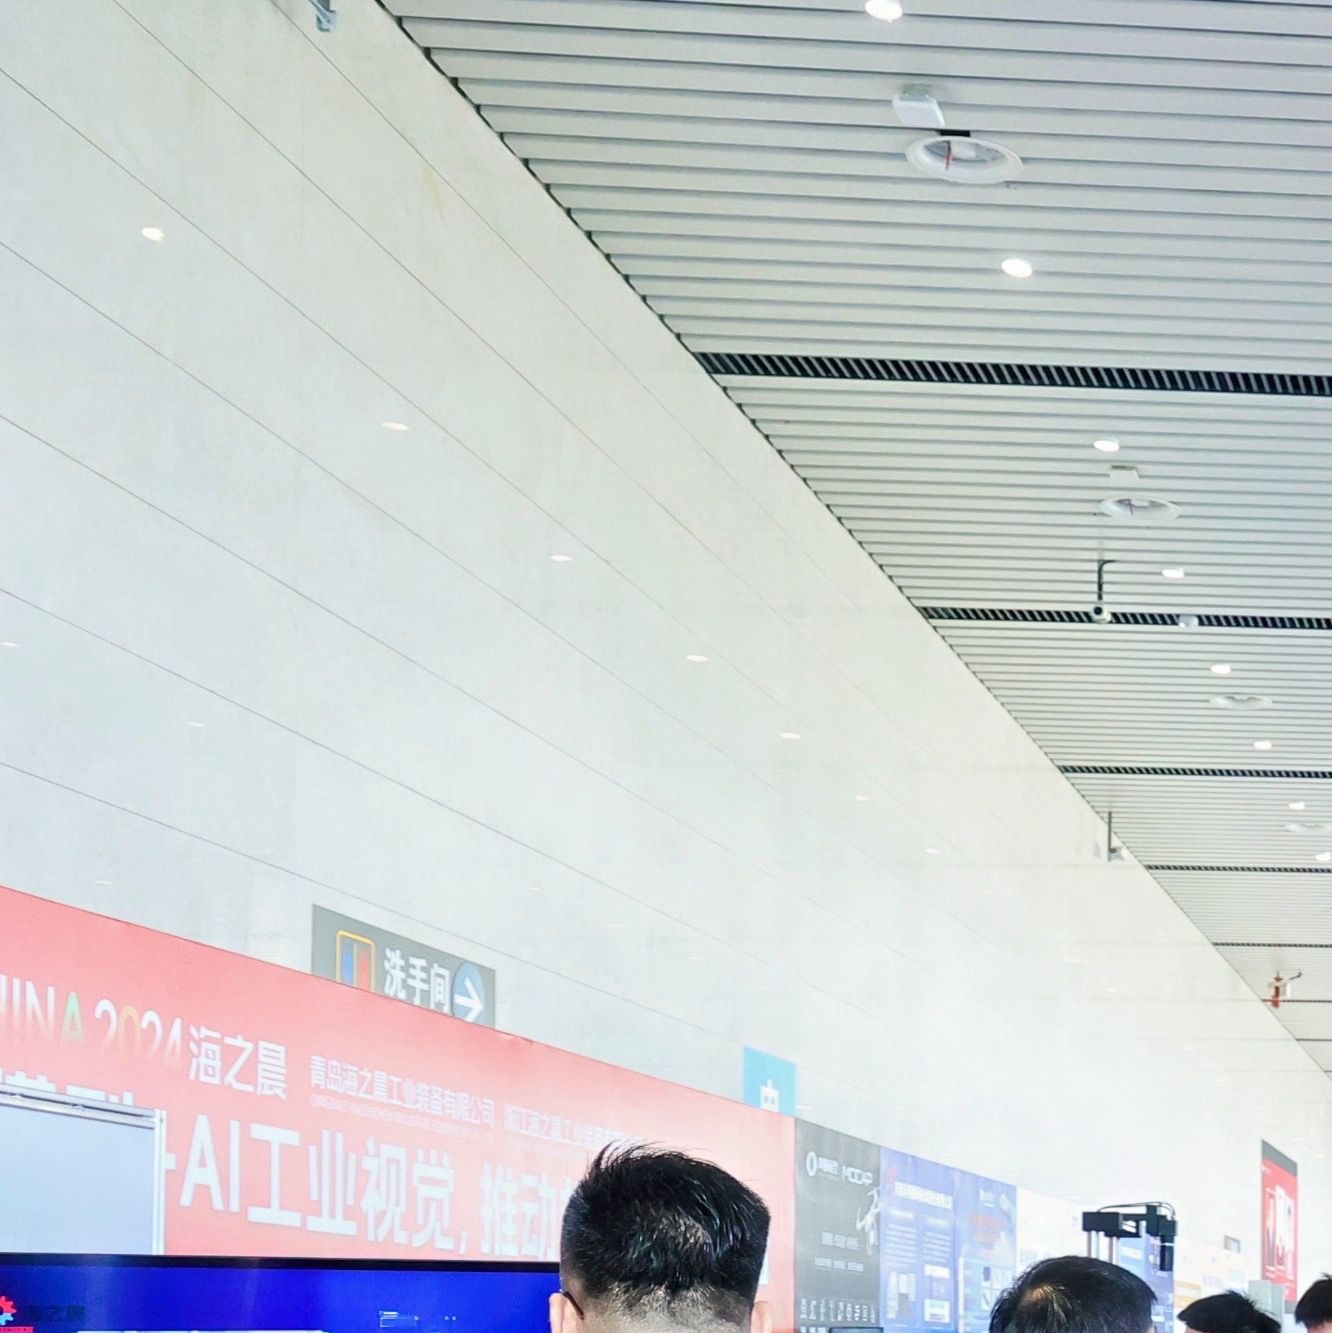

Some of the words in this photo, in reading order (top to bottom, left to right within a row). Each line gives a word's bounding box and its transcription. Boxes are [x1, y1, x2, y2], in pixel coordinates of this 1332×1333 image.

[384, 947, 450, 1014] 洗手间
[188, 1025, 287, 1099] 海之晨
